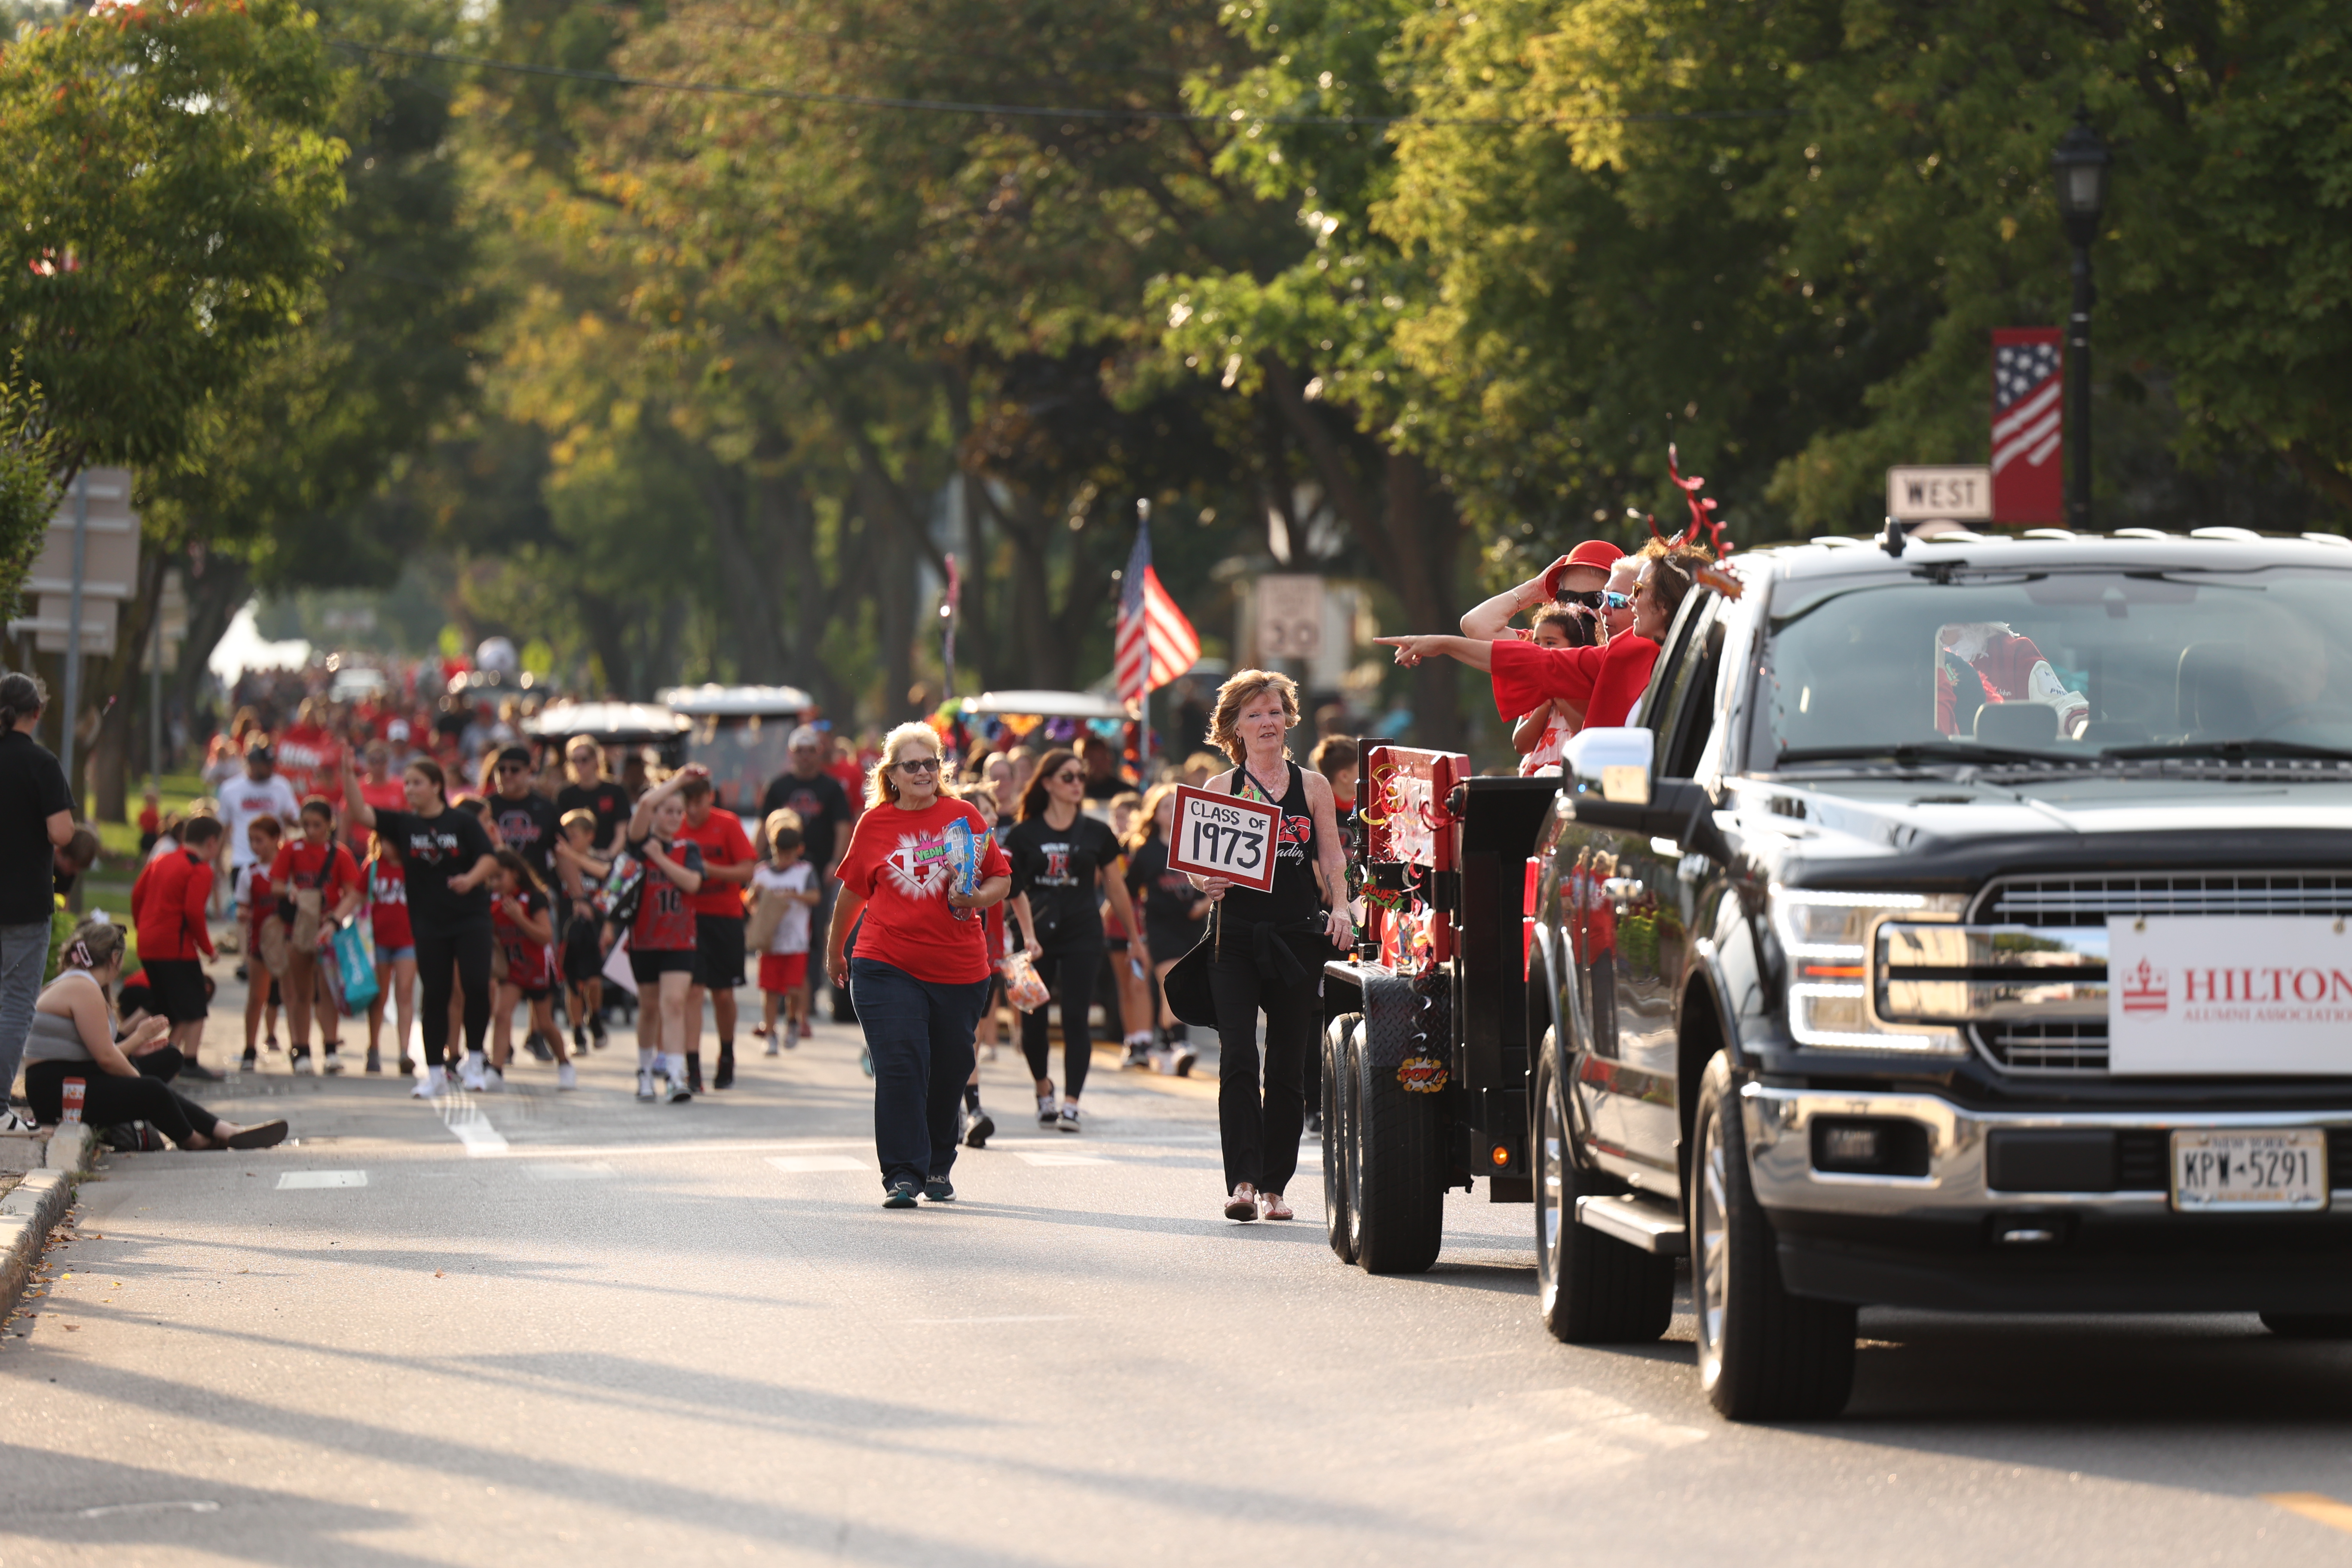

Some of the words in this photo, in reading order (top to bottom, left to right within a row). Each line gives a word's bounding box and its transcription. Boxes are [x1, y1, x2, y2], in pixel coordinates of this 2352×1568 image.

[1905, 478, 1975, 506] WEST
[1191, 801, 1240, 825] CLASS
[1249, 817, 1267, 830] OF
[1193, 821, 1264, 869] 1973
[2183, 967, 2352, 1002] HILTON
[2185, 1152, 2230, 1187] KPW
[2250, 1150, 2308, 1188] 5291
